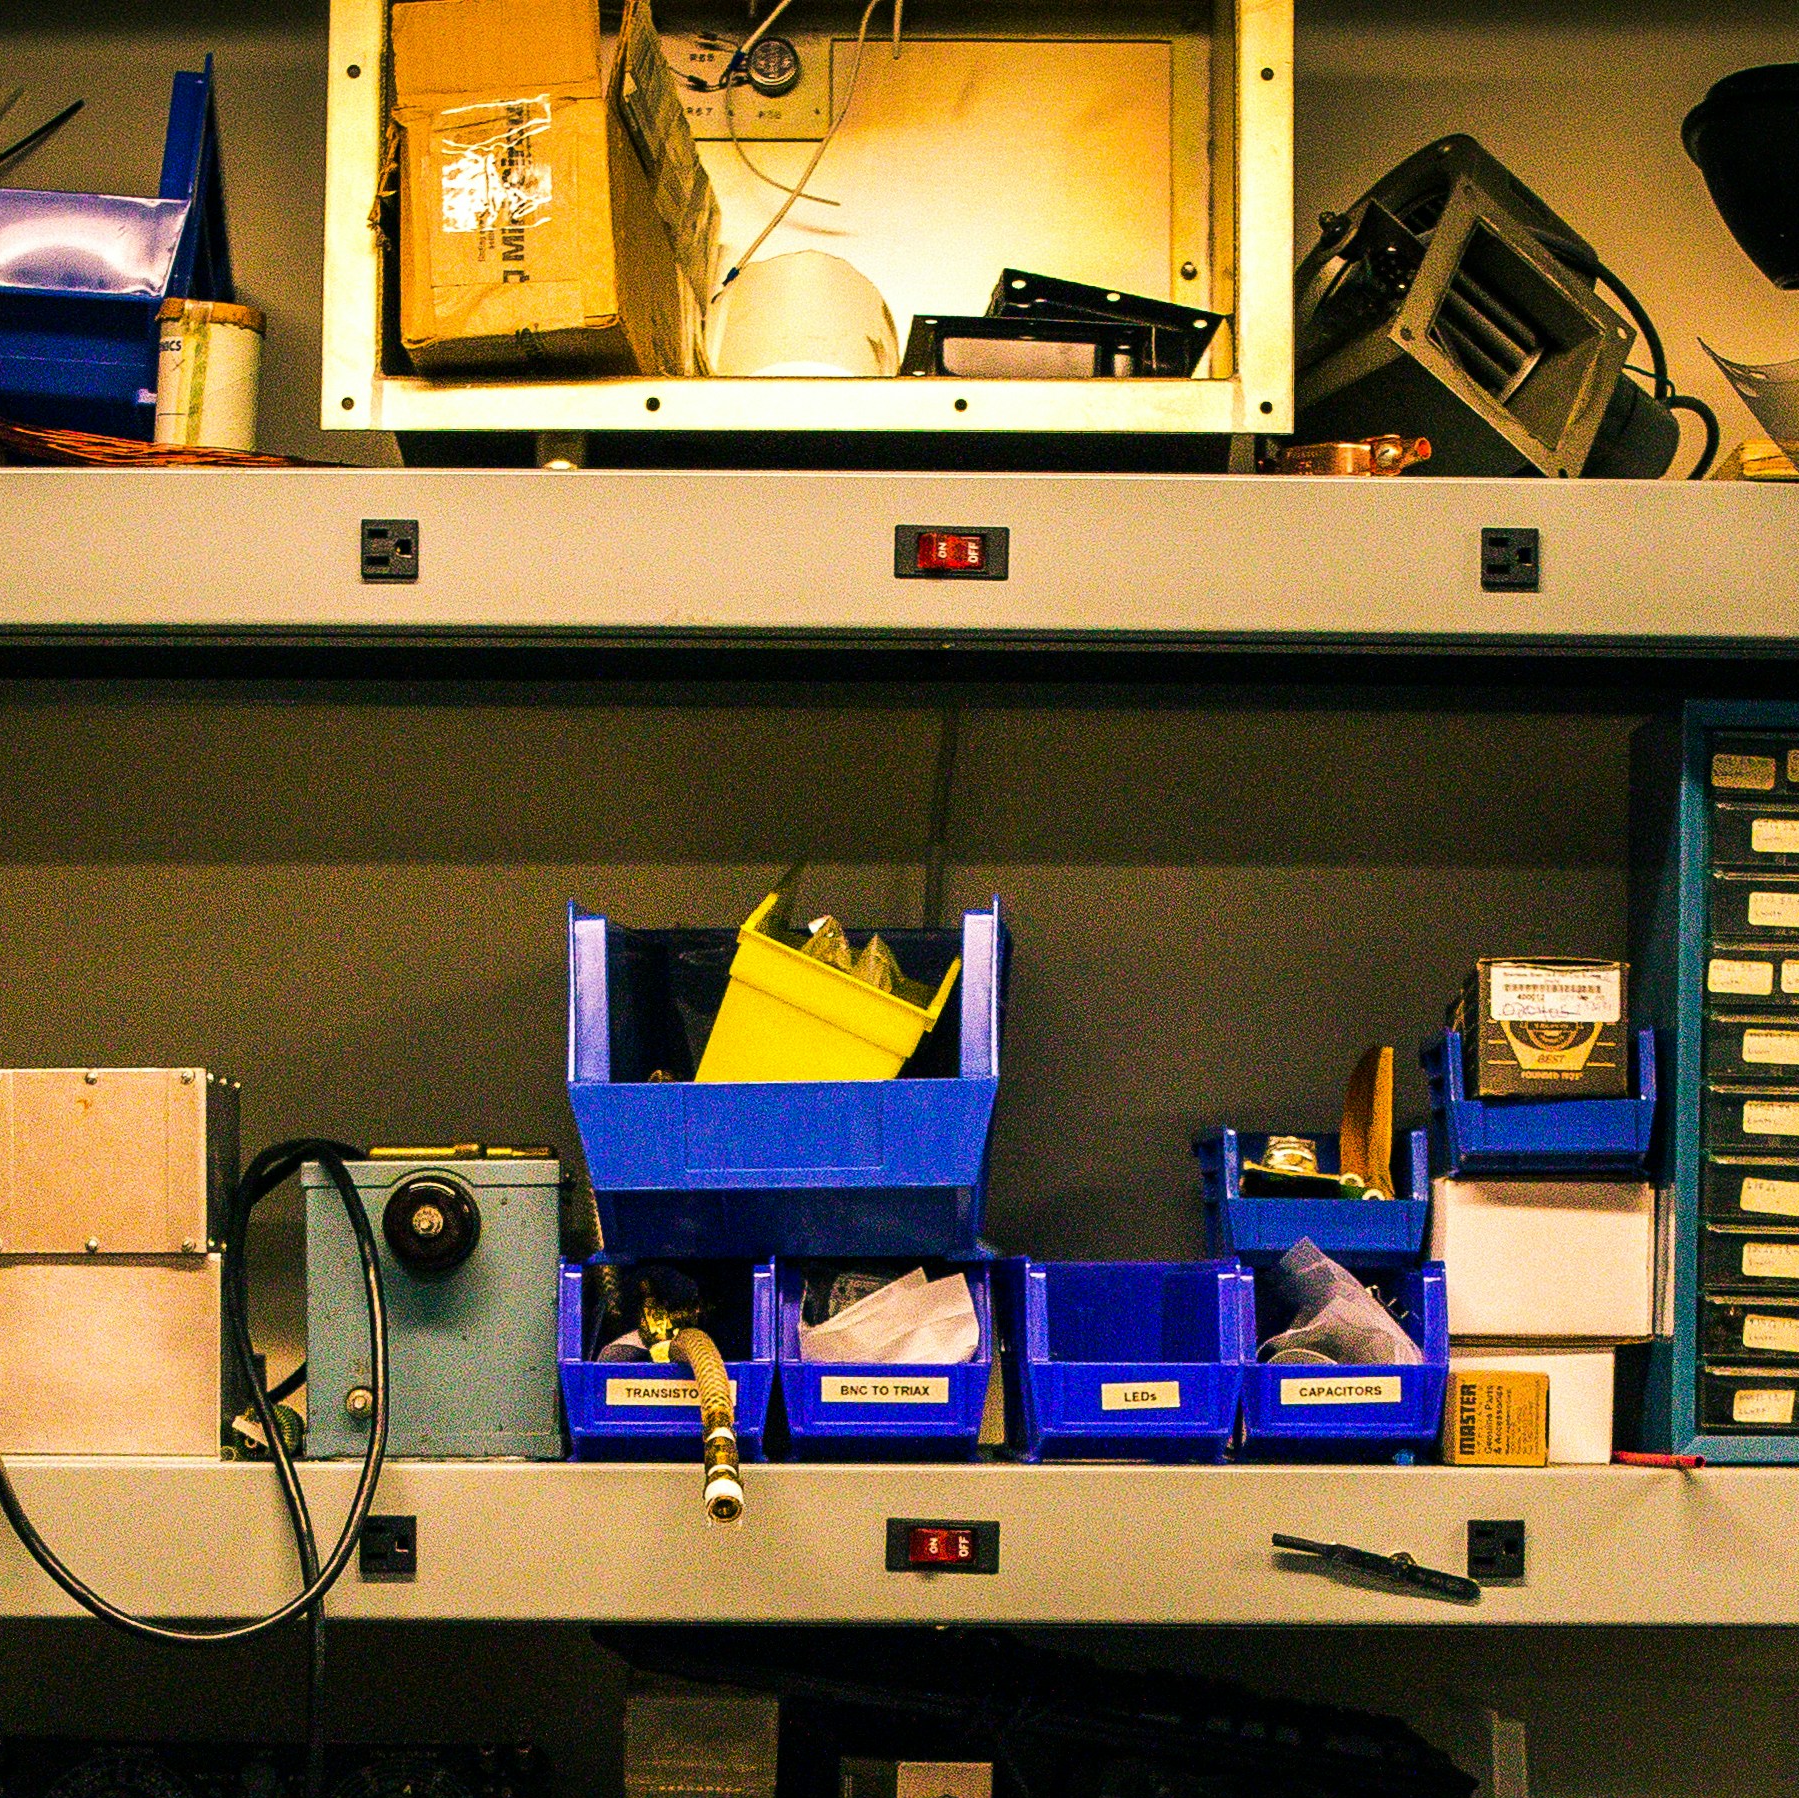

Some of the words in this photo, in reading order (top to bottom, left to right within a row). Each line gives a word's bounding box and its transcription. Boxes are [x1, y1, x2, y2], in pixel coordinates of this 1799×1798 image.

[937, 541, 947, 559] ON
[968, 541, 979, 563] OFF
[624, 1387, 700, 1400] TRANSISTO
[840, 1385, 868, 1397] BNC
[871, 1385, 890, 1397] TO
[892, 1385, 931, 1397] TRIAX
[1124, 1391, 1157, 1403] LEDs
[1299, 1385, 1382, 1398] CAPACITORS
[1459, 1384, 1477, 1456] MASTER
[928, 1537, 939, 1555] ON
[957, 1535, 969, 1558] OFF
